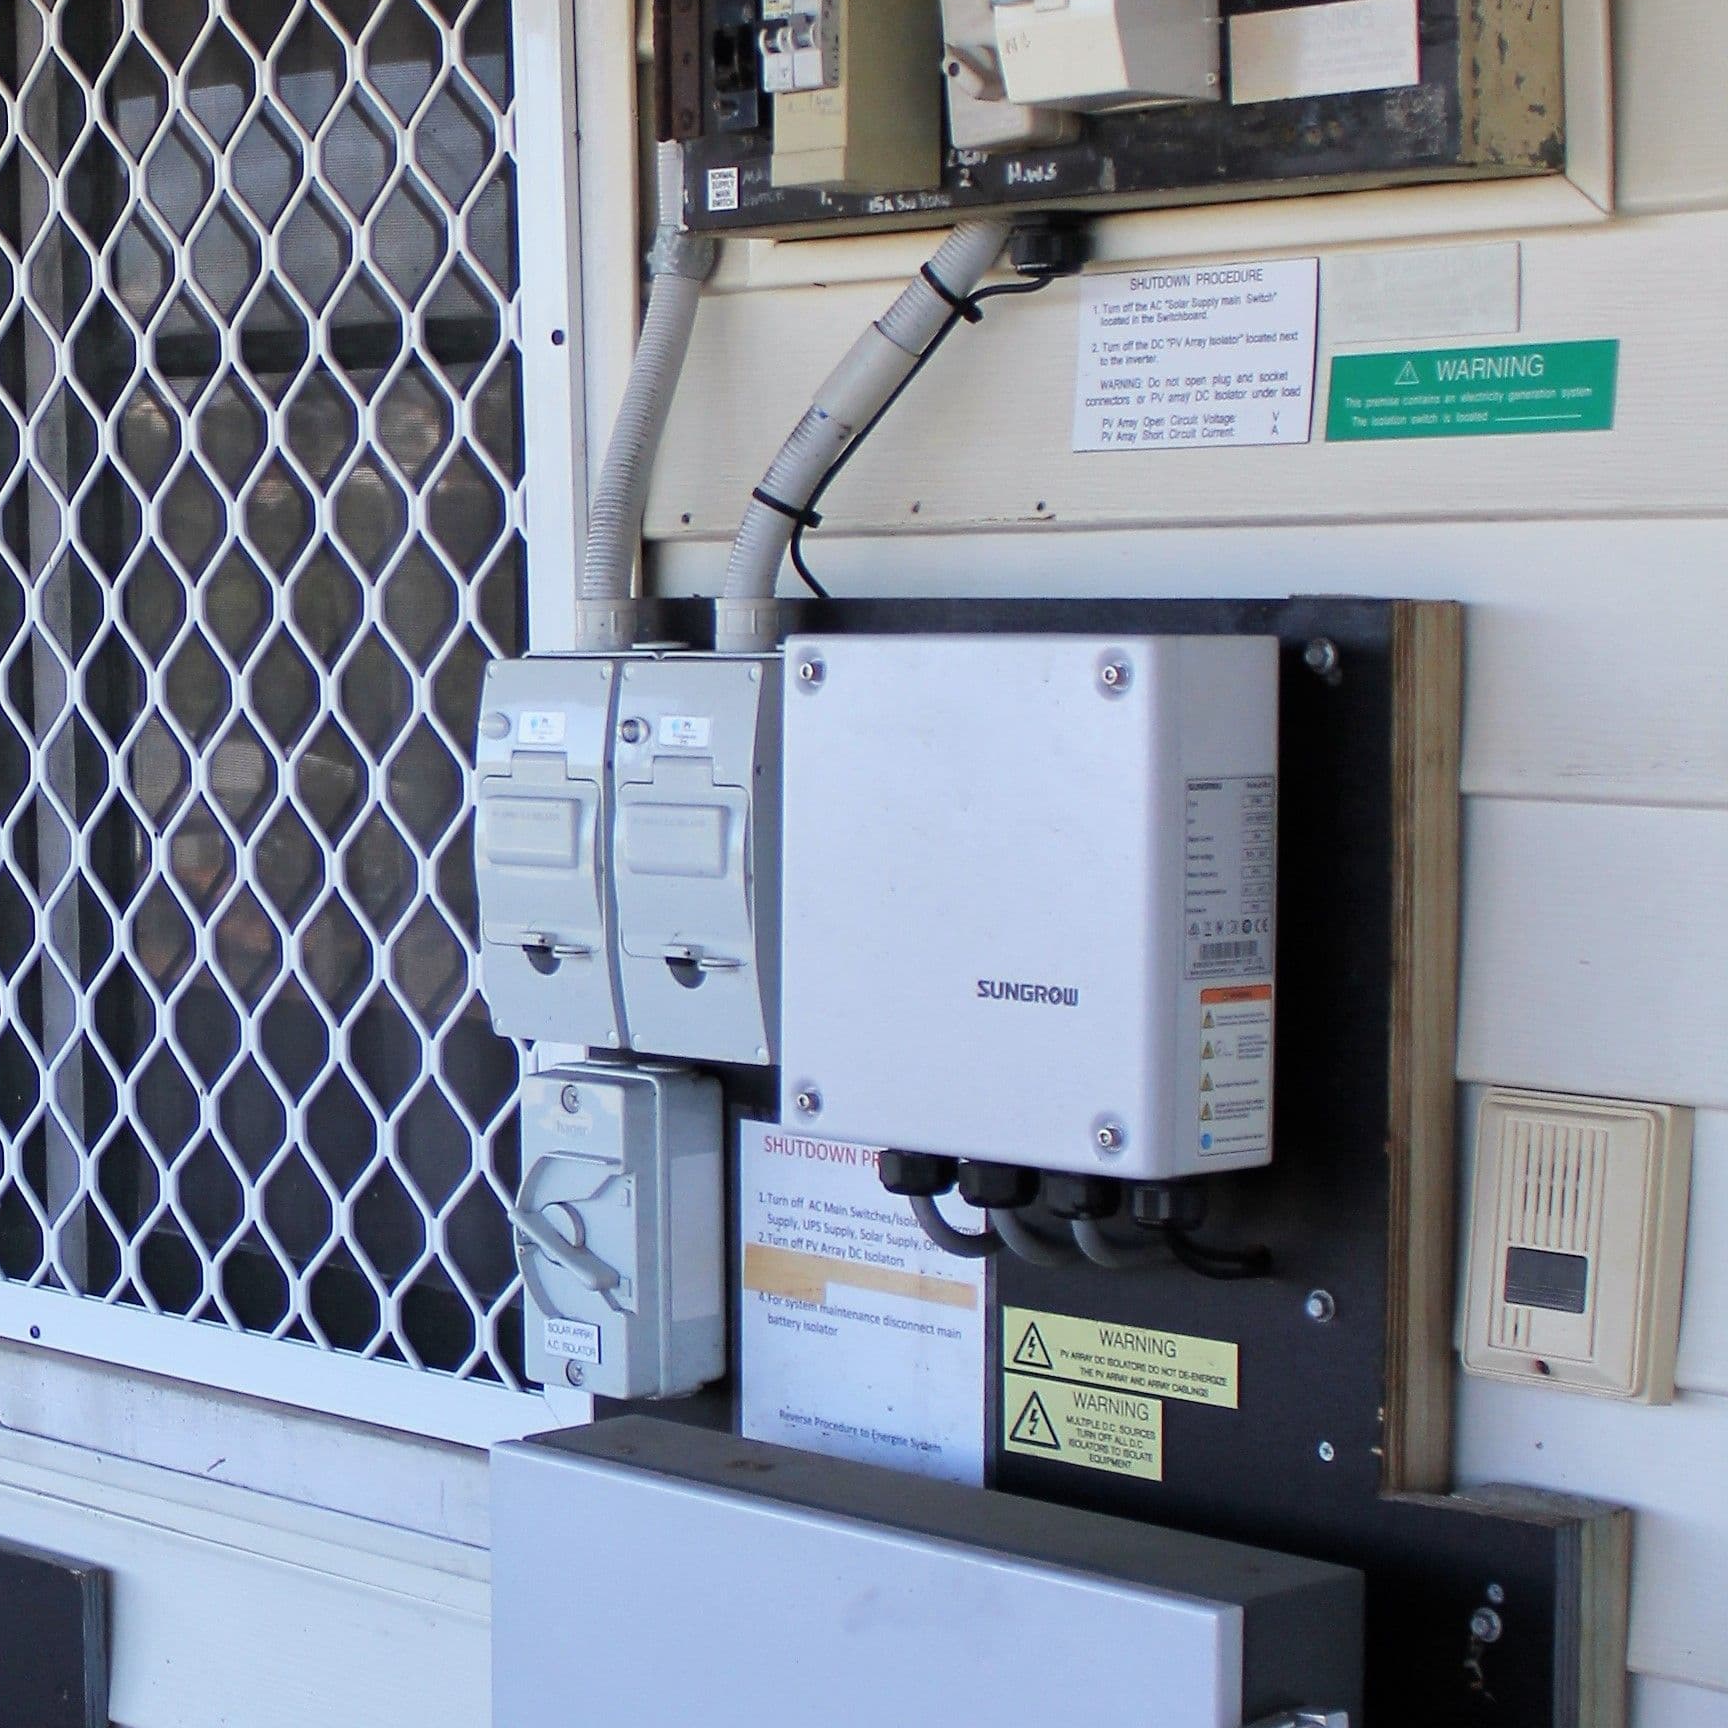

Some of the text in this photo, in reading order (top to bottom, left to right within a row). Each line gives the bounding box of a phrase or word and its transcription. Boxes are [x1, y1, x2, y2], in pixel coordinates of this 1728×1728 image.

[1131, 268, 1263, 291] SHUTDOWN PROCEDURE
[1192, 296, 1219, 309] Supply
[1152, 339, 1163, 350] DC
[1185, 336, 1206, 350] Array
[1437, 354, 1544, 382] WARNING
[1185, 376, 1206, 388] open
[1212, 374, 1231, 386] plug
[1236, 373, 1253, 384] and
[1259, 371, 1288, 383] socket
[1151, 393, 1163, 403] PV
[1168, 393, 1190, 404] array
[1195, 391, 1210, 402] DC
[1252, 388, 1279, 399] under
[1345, 396, 1361, 408] This
[1403, 394, 1440, 406] contains
[1445, 394, 1455, 403] an
[1460, 390, 1504, 403] electricity
[1508, 389, 1556, 402] generation
[1561, 388, 1592, 399] system
[1103, 418, 1113, 429] PV
[1117, 418, 1138, 429] Array
[1144, 417, 1165, 428] Open
[1170, 414, 1198, 425] Circuit
[1456, 411, 1488, 422] located
[1102, 431, 1112, 442] PV
[1116, 431, 1137, 443] Array
[1142, 429, 1164, 440] Short
[1168, 428, 1196, 440] Circuit
[977, 979, 1079, 1006] SUNGROW
[764, 1135, 856, 1166] SHUTDOWN
[791, 1198, 805, 1209] off
[809, 1201, 822, 1211] AC
[824, 1202, 847, 1216] Main
[803, 1220, 822, 1233] UPS
[860, 1229, 883, 1243] Solar
[791, 1238, 804, 1249] off
[806, 1240, 819, 1250] PV
[821, 1242, 846, 1259] Array
[849, 1246, 862, 1259] DC
[767, 1312, 801, 1332] battery
[768, 1292, 784, 1305] For
[785, 1297, 818, 1313] system
[820, 1303, 881, 1325] maintenance
[883, 1314, 933, 1335] disconnect
[937, 1325, 961, 1340] main
[548, 1323, 572, 1336] SOLAR
[563, 1342, 596, 1357] ISOLATOR
[1099, 1329, 1177, 1358] WARNING
[1060, 1349, 1070, 1360] PV
[1071, 1351, 1093, 1364] ARRAY
[1094, 1355, 1105, 1365] DC
[1107, 1357, 1146, 1374] ISOLATORS
[1148, 1363, 1159, 1375] DO
[1161, 1366, 1176, 1377] NOT
[1081, 1367, 1094, 1377] THE
[1095, 1370, 1104, 1379] PV
[1106, 1372, 1129, 1385] ARRAY
[1131, 1376, 1146, 1387] AND
[1148, 1378, 1170, 1391] ARRAY
[1073, 1392, 1149, 1421] WARNING
[779, 1409, 812, 1425] Reverse
[814, 1416, 858, 1436] Procedure
[860, 1428, 869, 1438] to
[910, 1438, 942, 1453] System
[1066, 1415, 1100, 1430] MULTIPLE
[1119, 1424, 1156, 1440] SOURCES
[1077, 1428, 1128, 1446] TURN OFF ALL
[1069, 1438, 1153, 1463] ISOLATORS TO ISOLATE
[1089, 1453, 1132, 1470] EQUIPMENT
